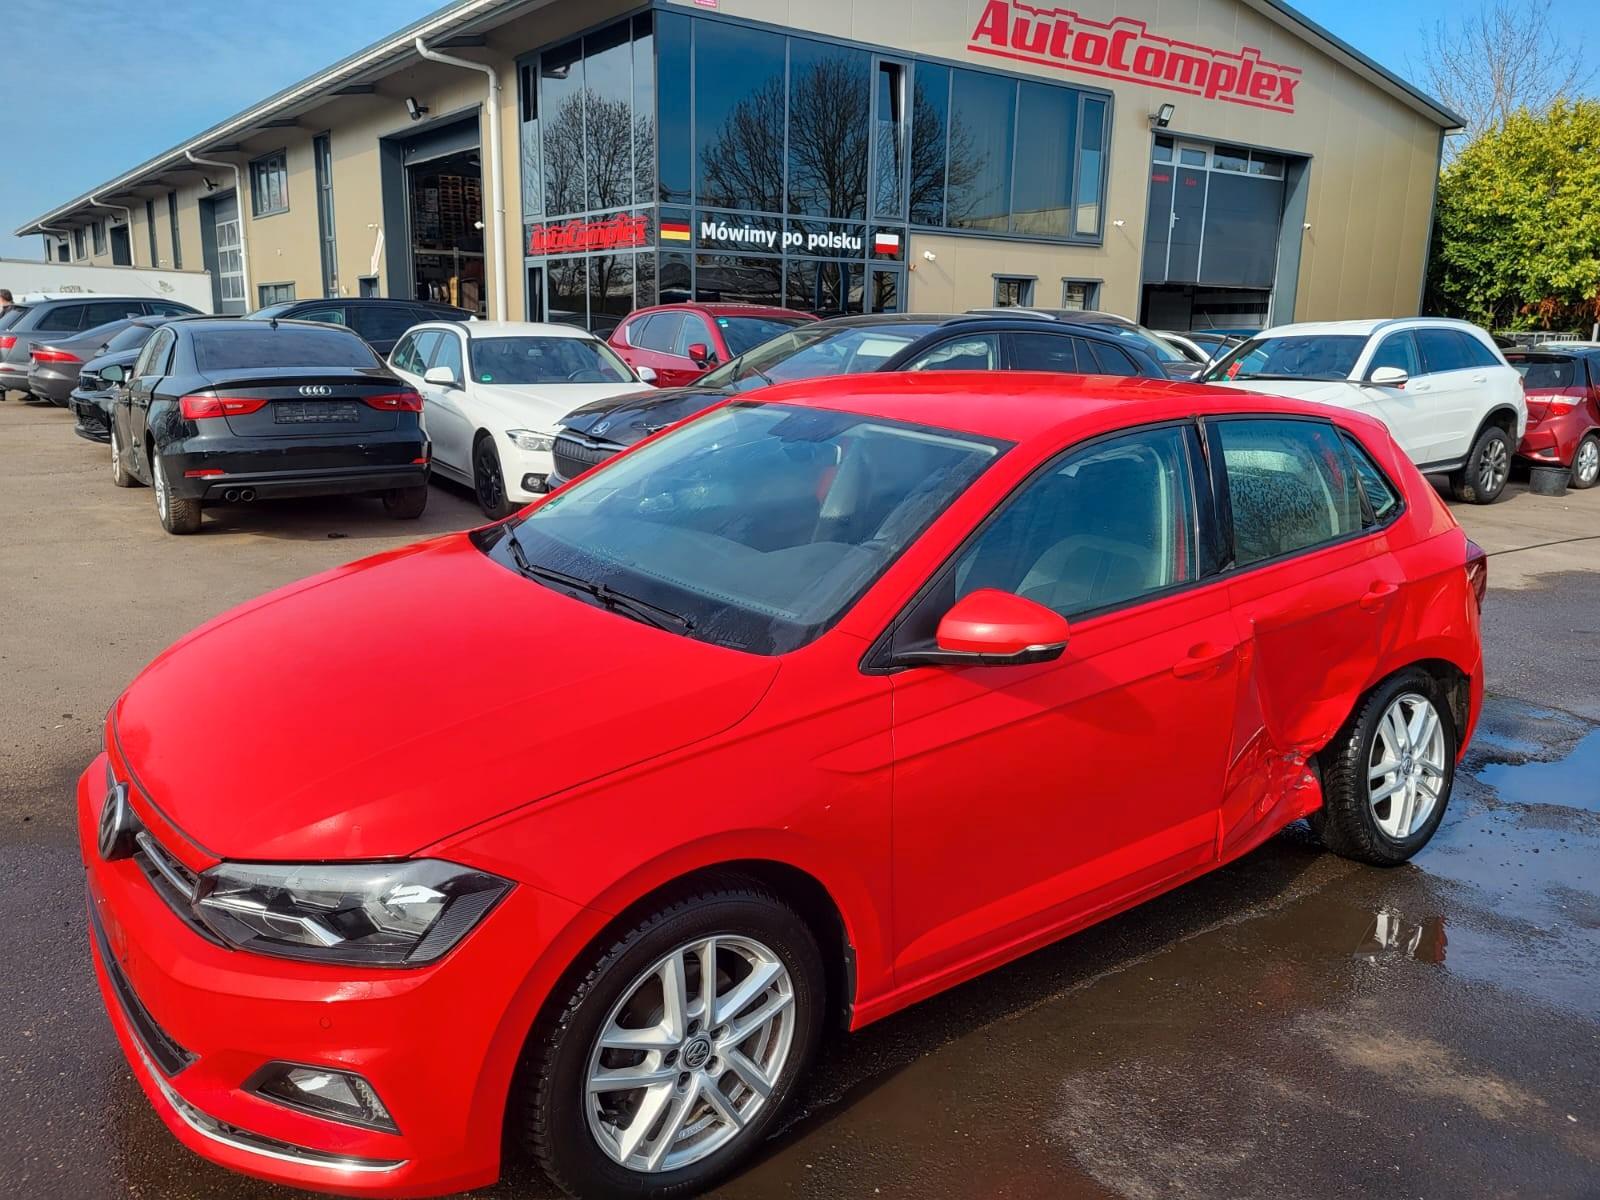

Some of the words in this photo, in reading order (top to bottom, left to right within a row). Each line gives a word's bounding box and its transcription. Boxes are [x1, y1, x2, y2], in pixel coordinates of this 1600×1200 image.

[971, 0, 1299, 104] AutoComplex
[529, 217, 648, 251] AutoComplex
[701, 221, 776, 248] Mówimy
[782, 231, 803, 249] po
[808, 231, 862, 250] polsku
